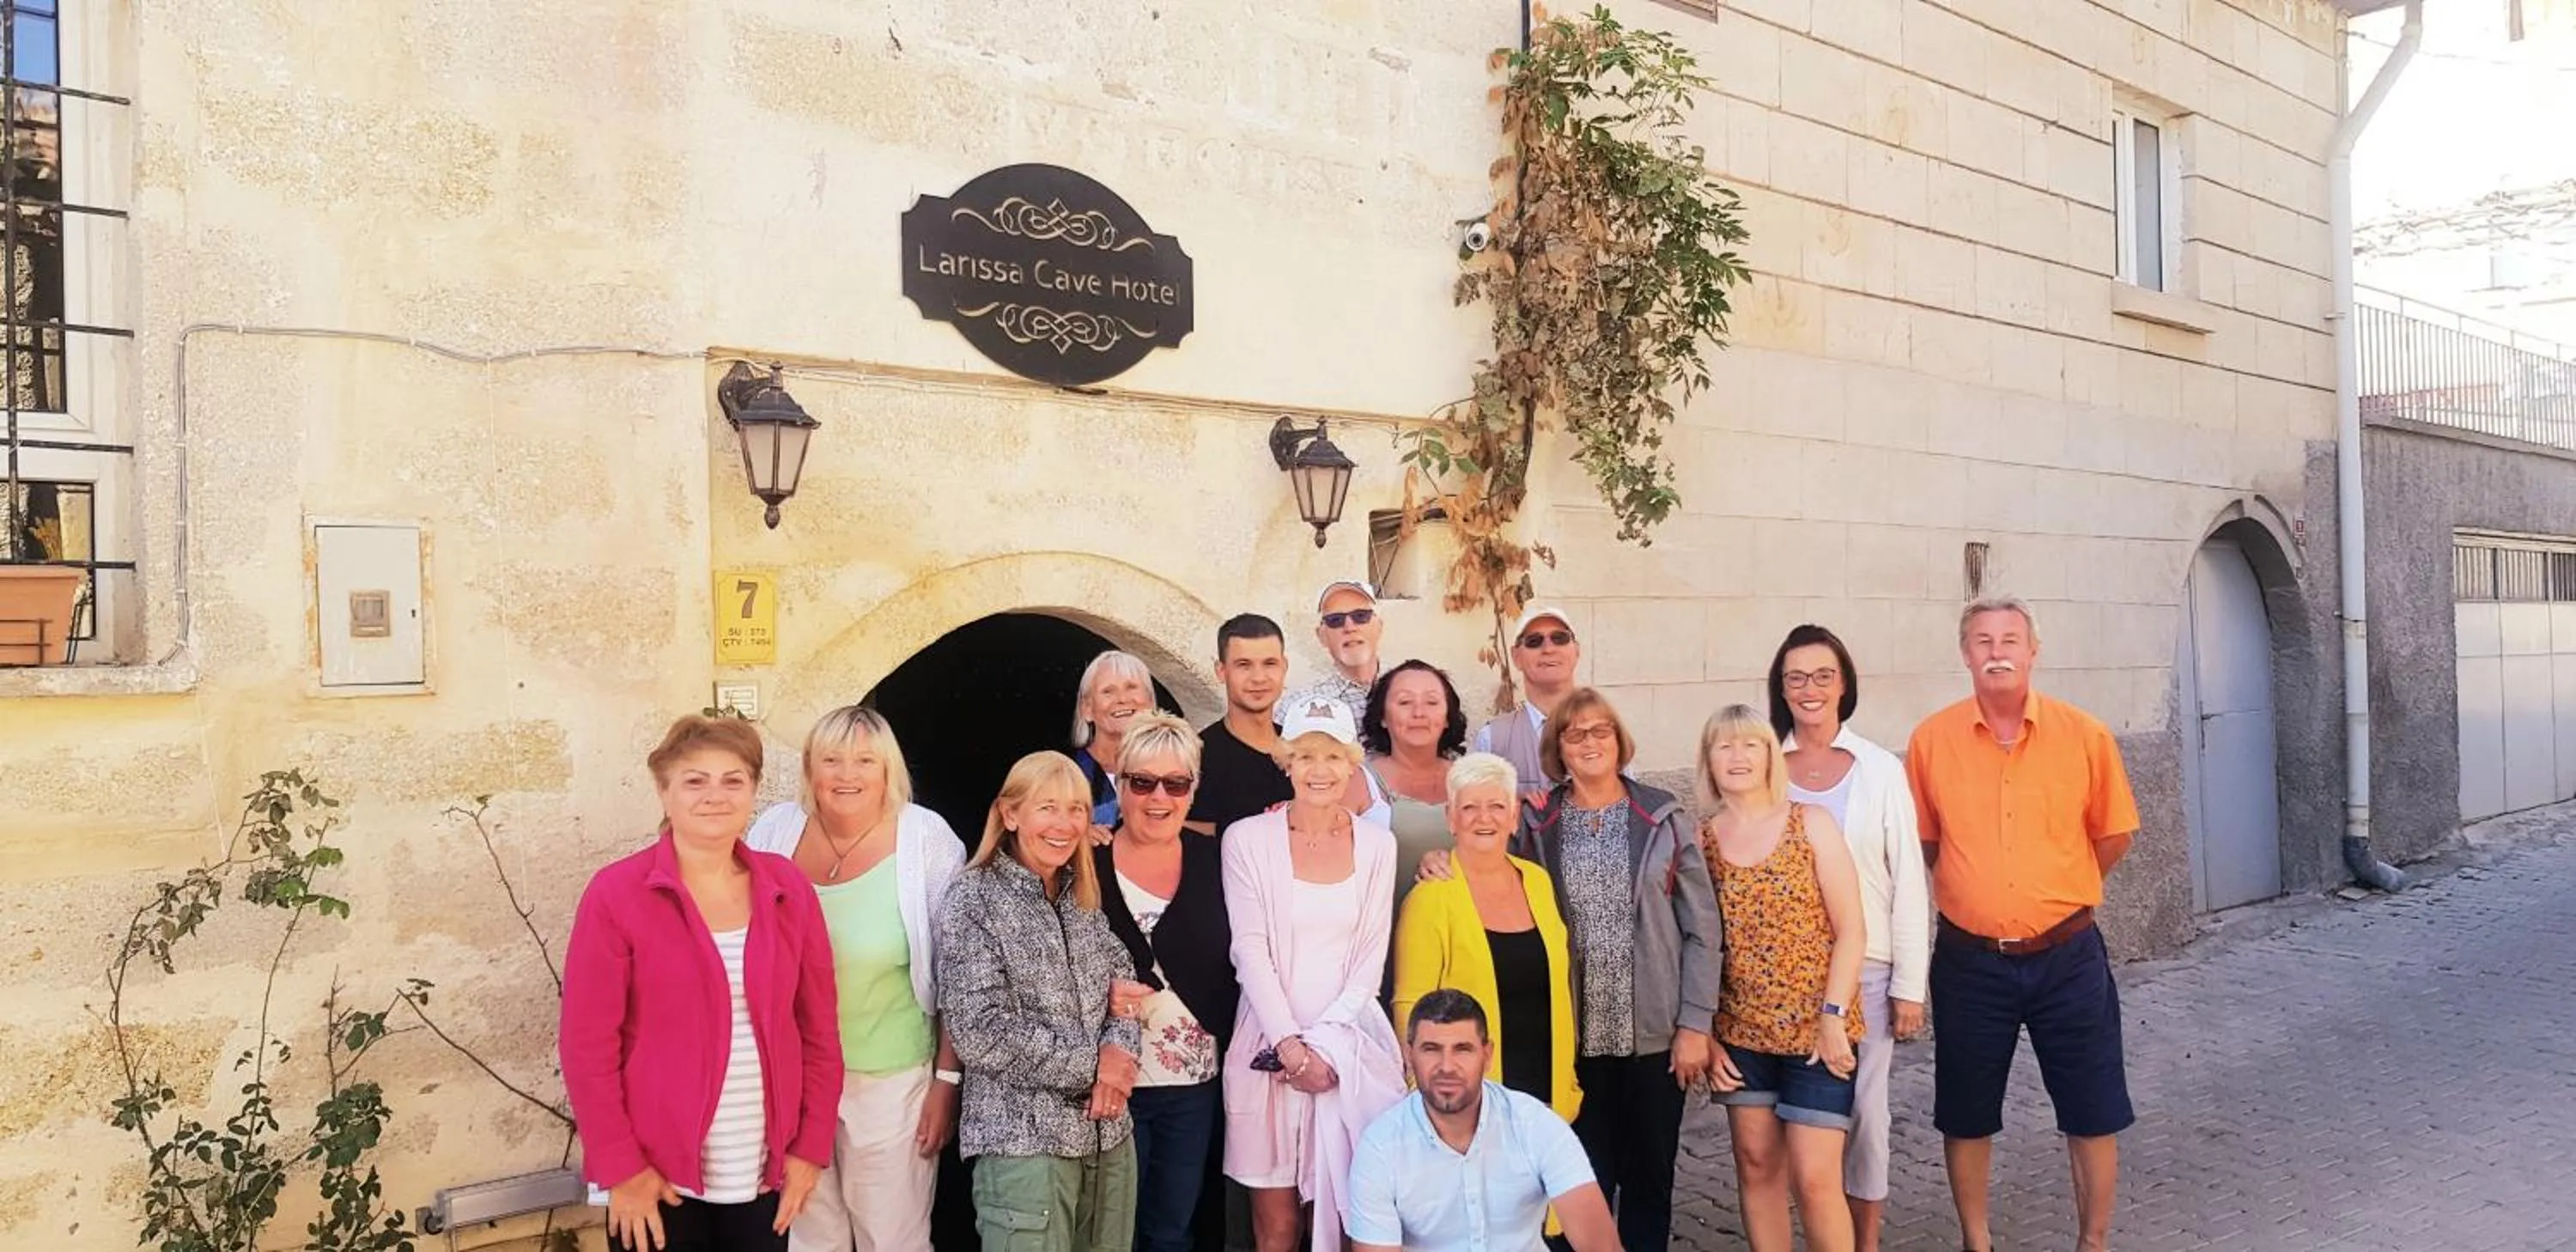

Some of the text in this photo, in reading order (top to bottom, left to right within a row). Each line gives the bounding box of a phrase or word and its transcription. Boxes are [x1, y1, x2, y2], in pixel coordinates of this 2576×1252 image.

[918, 244, 1181, 306] Larissa Cave Hotel
[737, 580, 758, 618] 7
